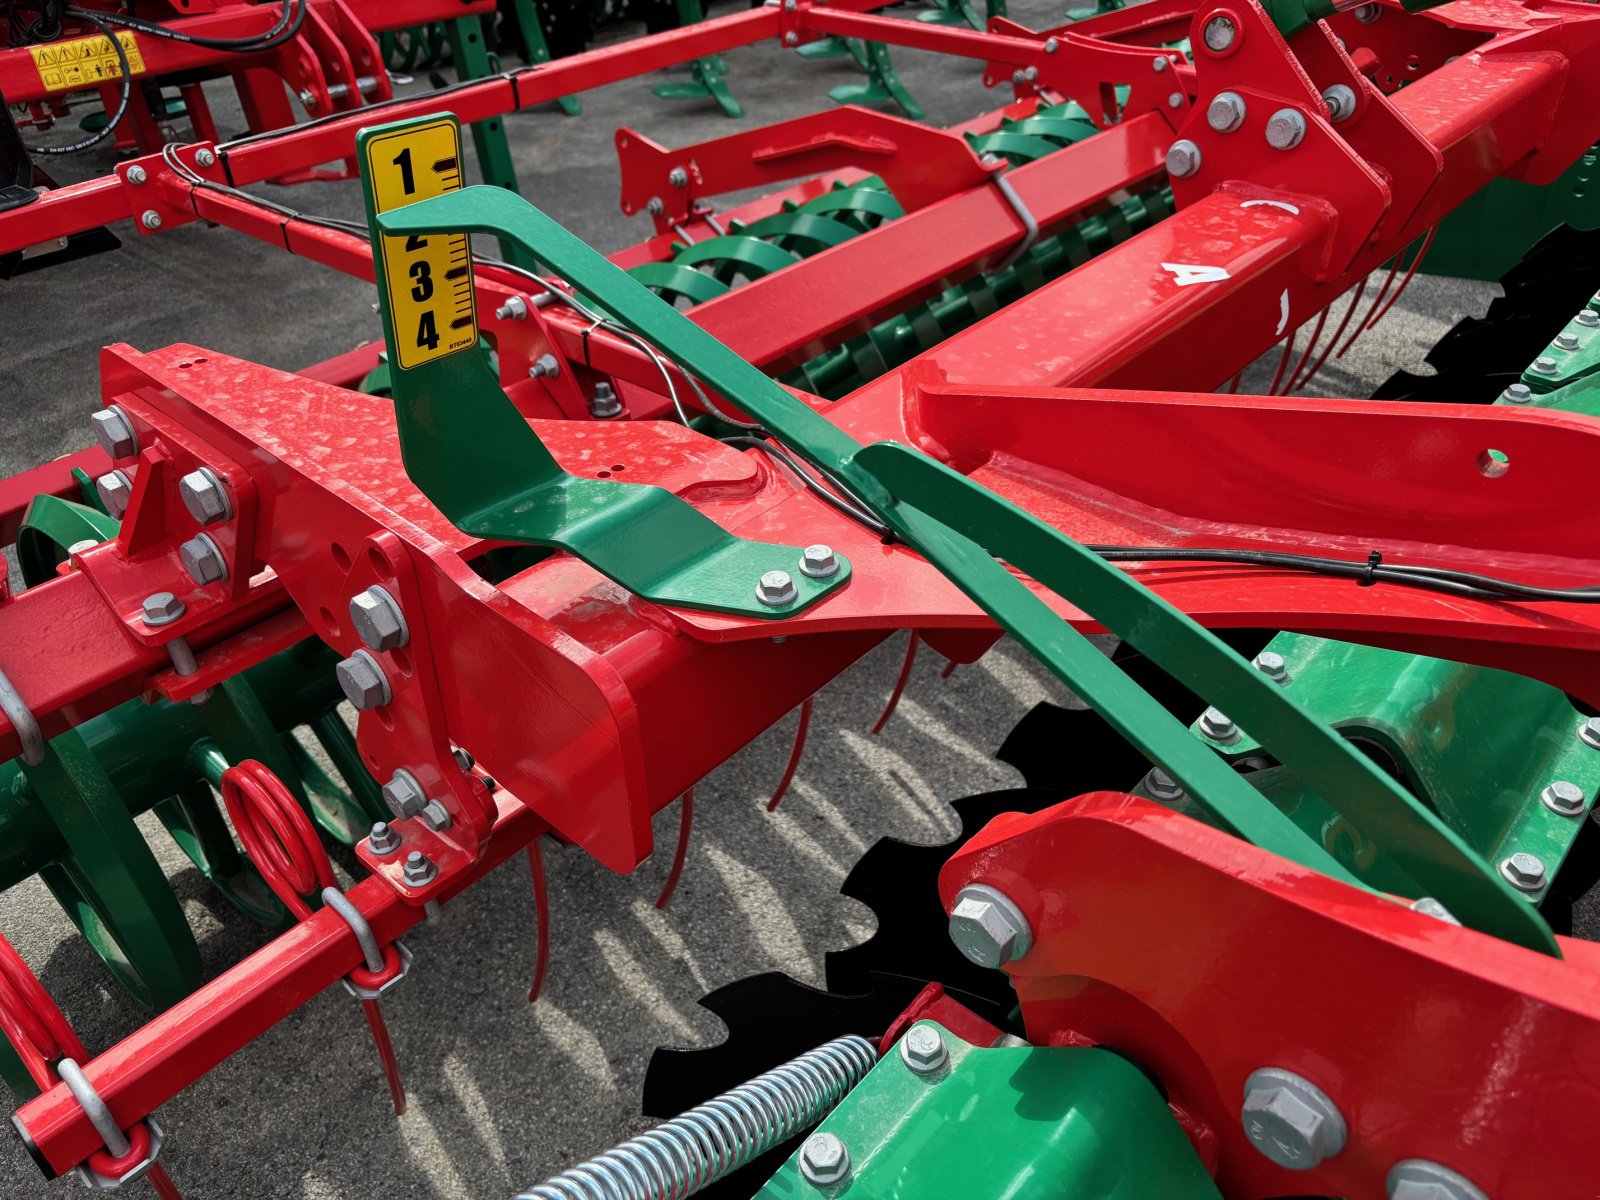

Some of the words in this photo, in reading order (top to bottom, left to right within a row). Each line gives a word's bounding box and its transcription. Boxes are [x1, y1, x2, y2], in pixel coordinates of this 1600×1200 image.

[392, 147, 416, 196] 1
[409, 260, 434, 303] 3
[416, 310, 441, 351] 4
